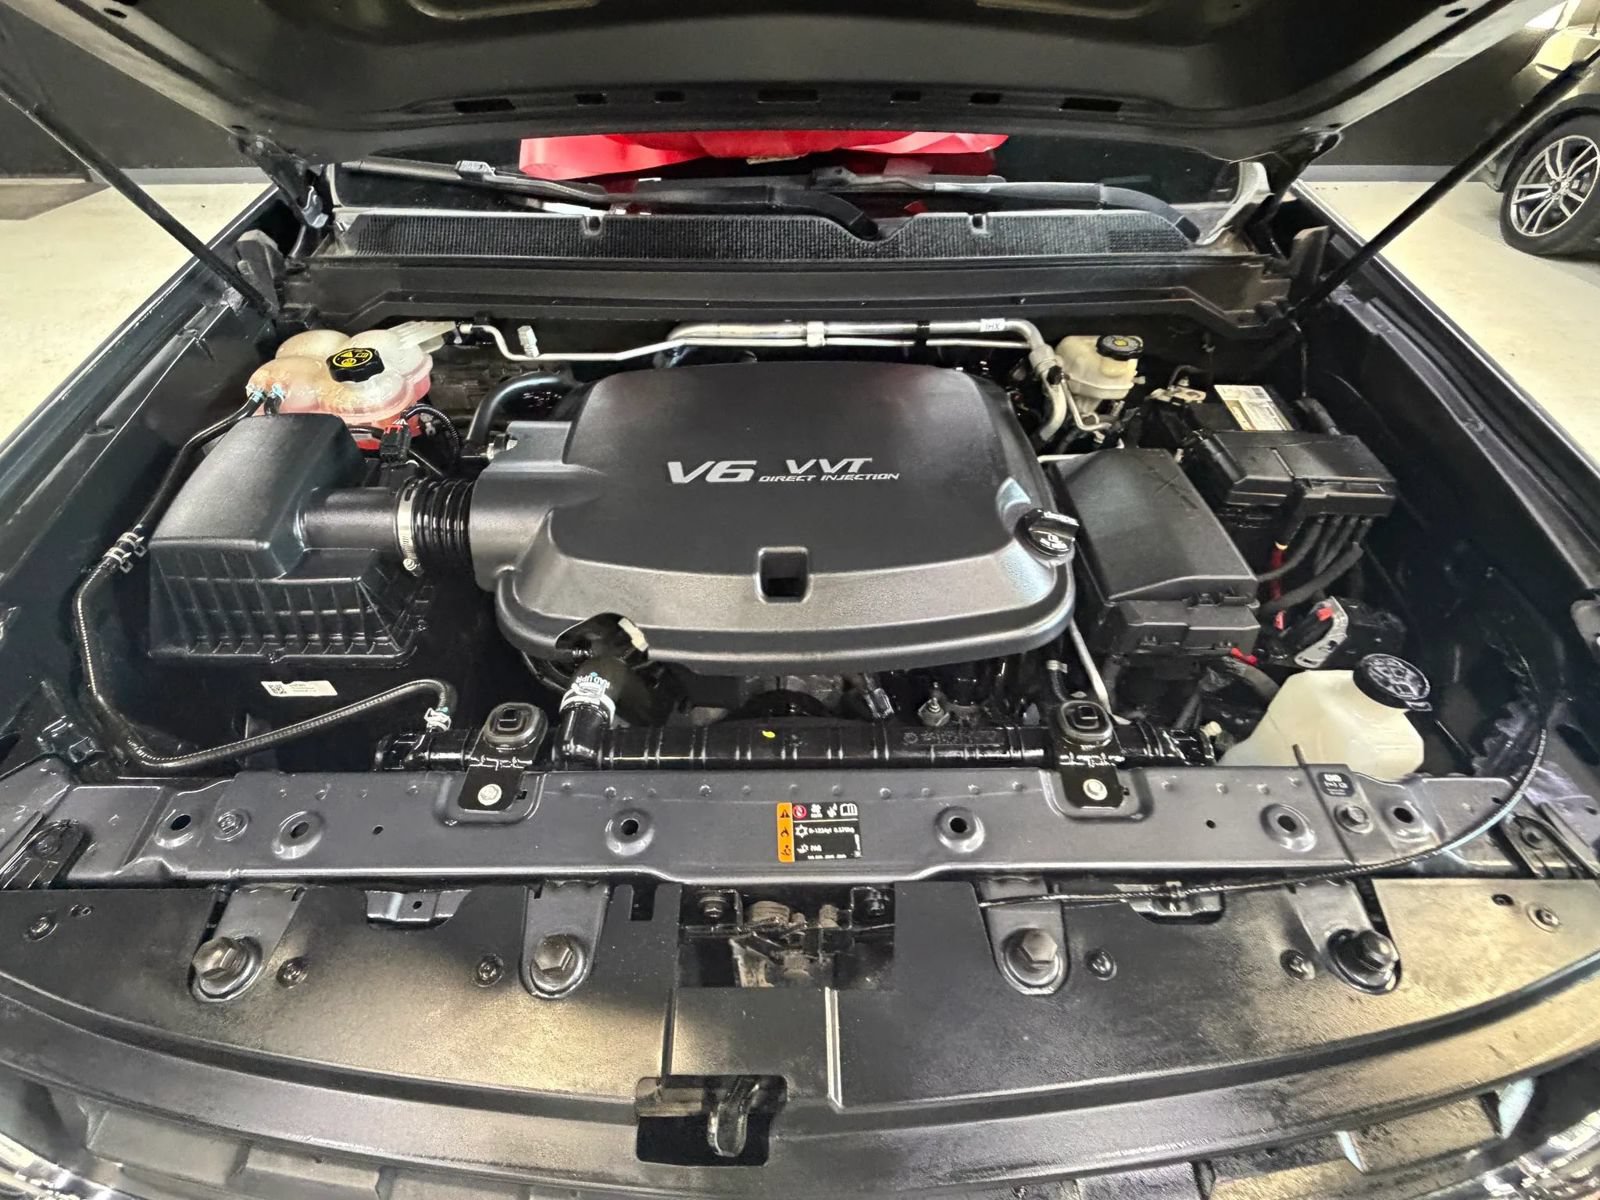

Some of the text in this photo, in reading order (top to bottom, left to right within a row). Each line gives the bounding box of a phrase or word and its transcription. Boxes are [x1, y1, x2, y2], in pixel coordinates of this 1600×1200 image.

[667, 460, 758, 484] V6
[785, 457, 873, 474] VVT
[758, 472, 900, 482] DIRECT INJECTION
